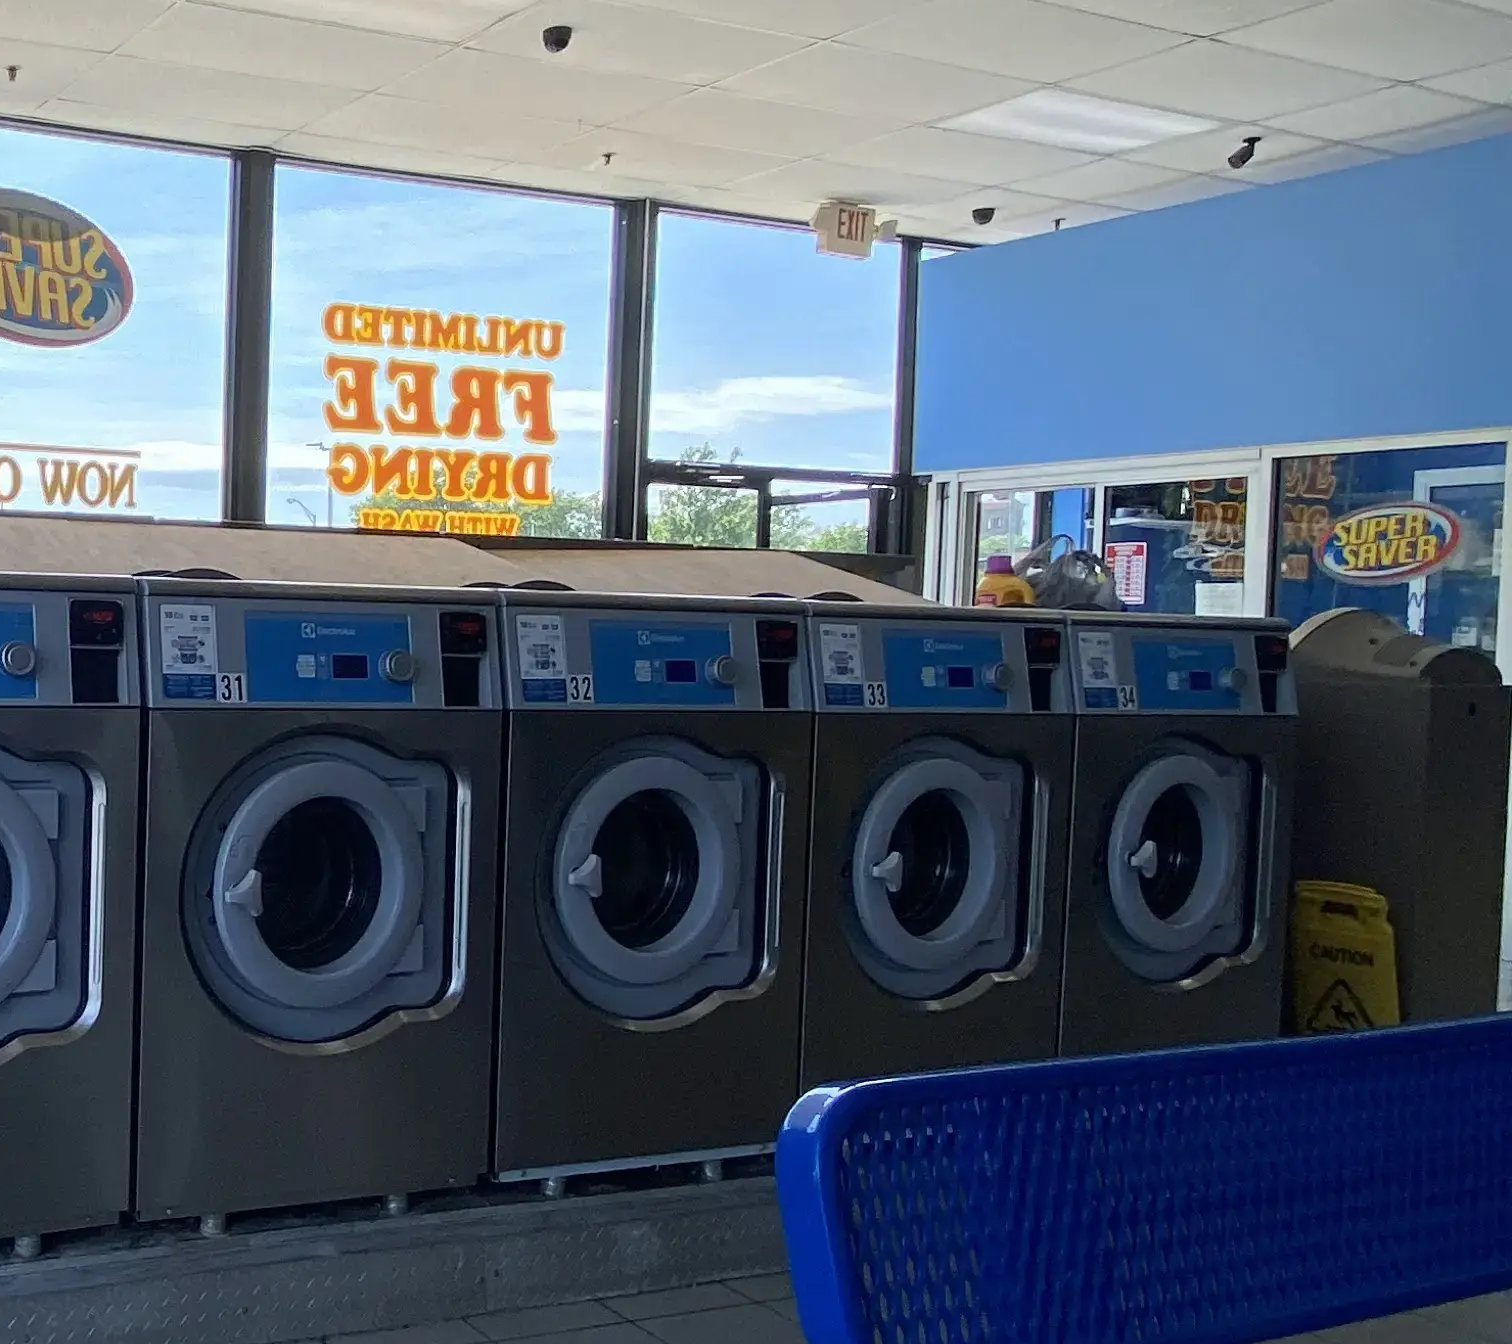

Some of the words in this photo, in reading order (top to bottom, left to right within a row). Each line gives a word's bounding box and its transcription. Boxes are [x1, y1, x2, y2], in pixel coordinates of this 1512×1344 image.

[838, 207, 870, 244] EXIT
[1334, 511, 1428, 547] SUPER
[1343, 534, 1438, 571] SAVER
[221, 674, 243, 701] 31
[570, 676, 592, 701] 32
[867, 683, 885, 706] 33
[1119, 686, 1135, 708] 34
